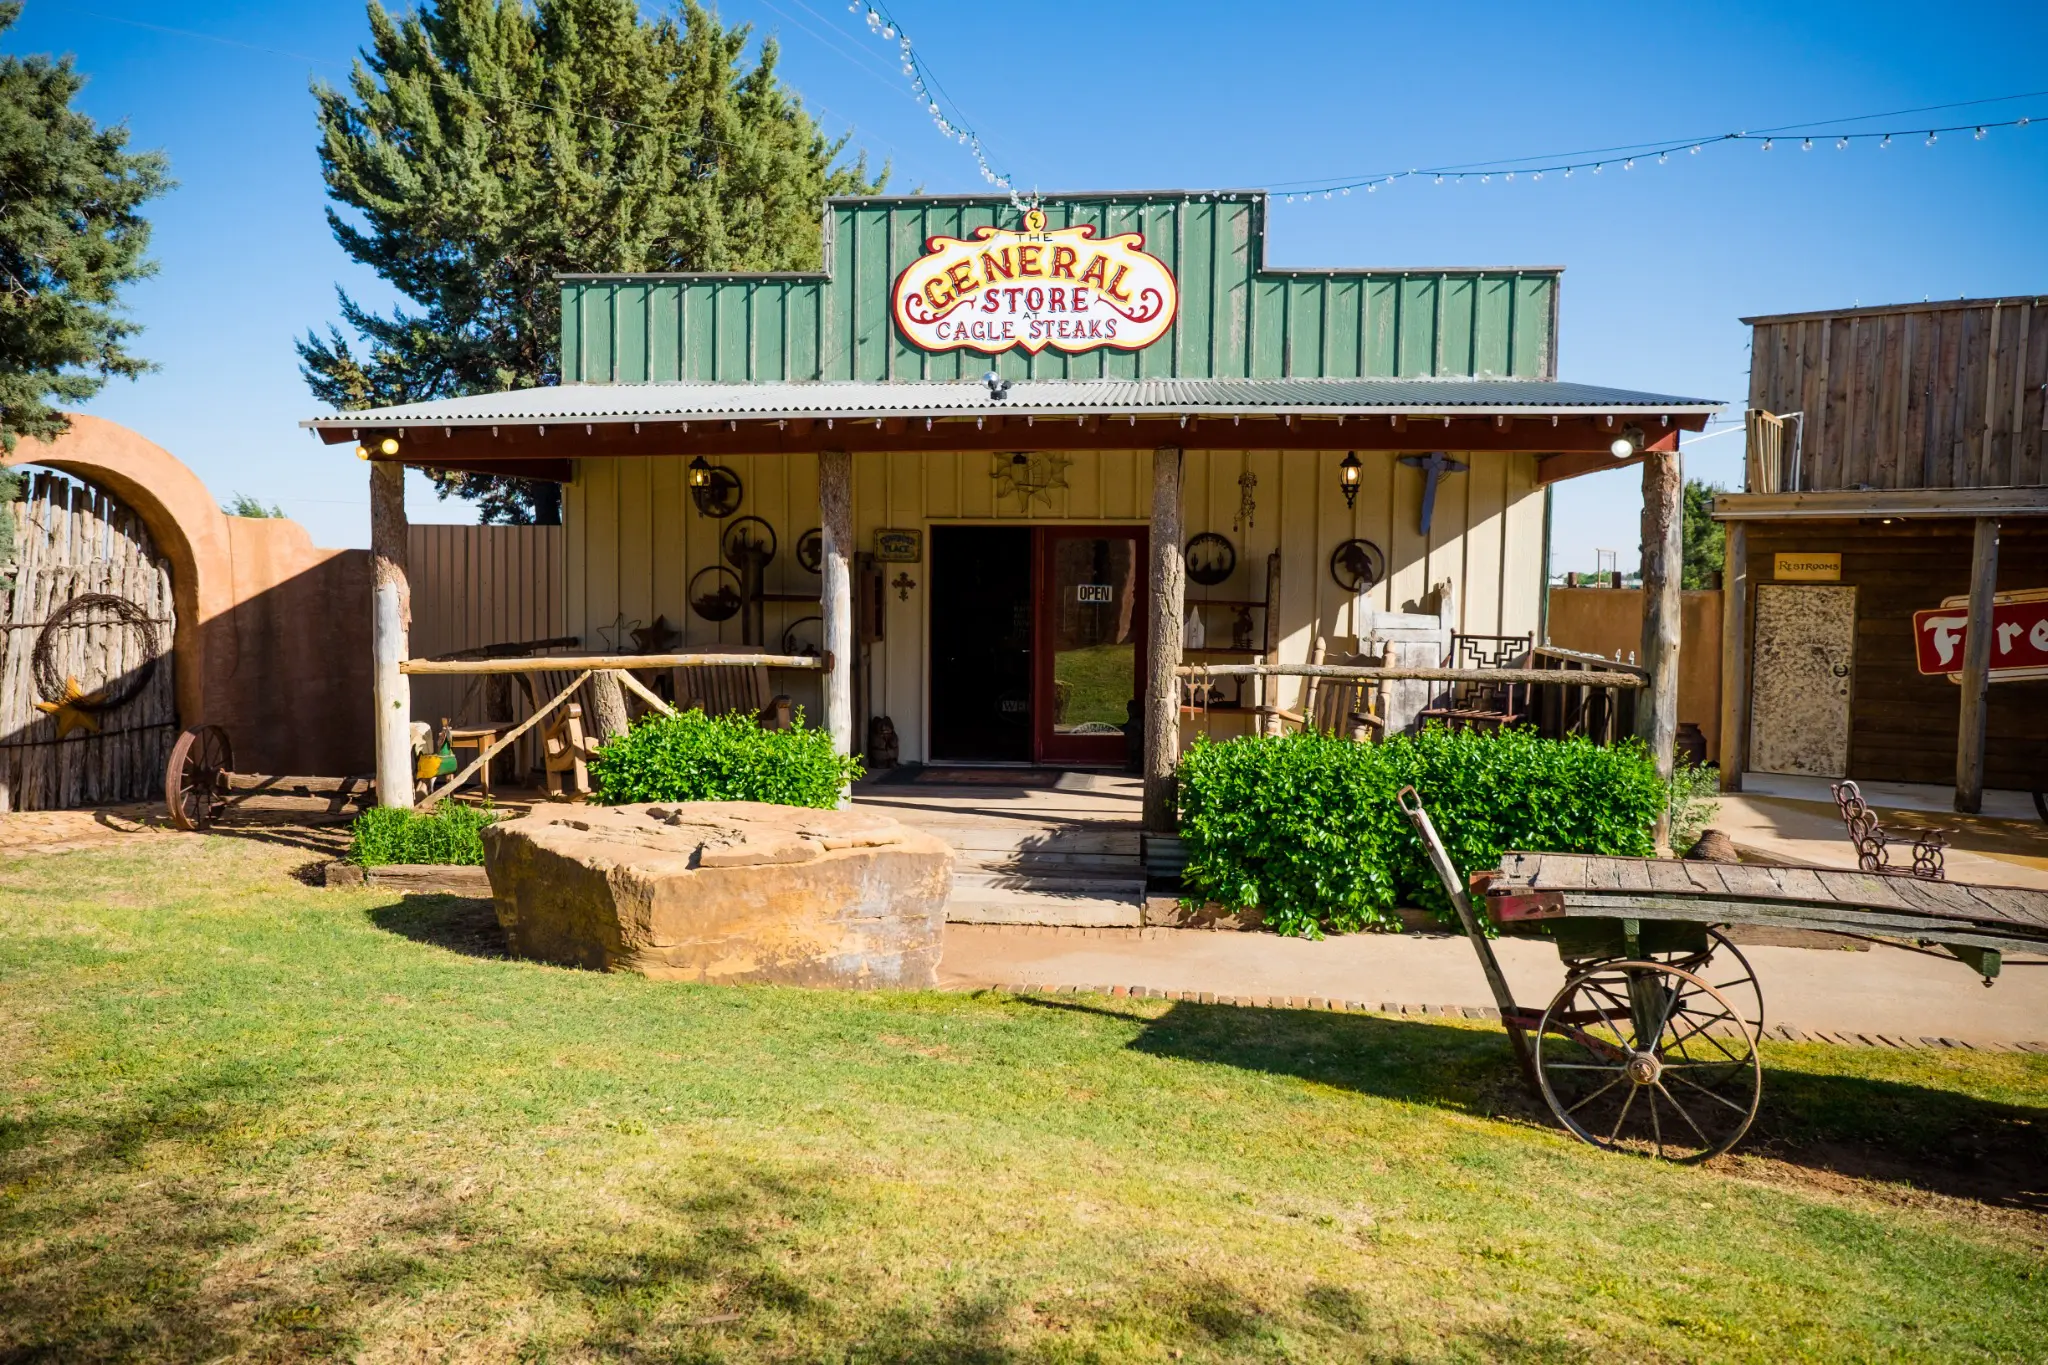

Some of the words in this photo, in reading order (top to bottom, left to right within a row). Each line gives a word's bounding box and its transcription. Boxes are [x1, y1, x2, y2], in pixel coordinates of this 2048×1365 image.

[1014, 232, 1054, 242] THE
[924, 245, 1134, 310] GENERAL
[981, 287, 1090, 314] STORE
[1022, 311, 1040, 320] AT
[935, 320, 1016, 341] CAGLE
[1028, 318, 1119, 341] STEAKS
[1778, 560, 1840, 572] RESTROOMS
[1079, 586, 1110, 601] OPEN
[1923, 616, 2048, 667] Fre
